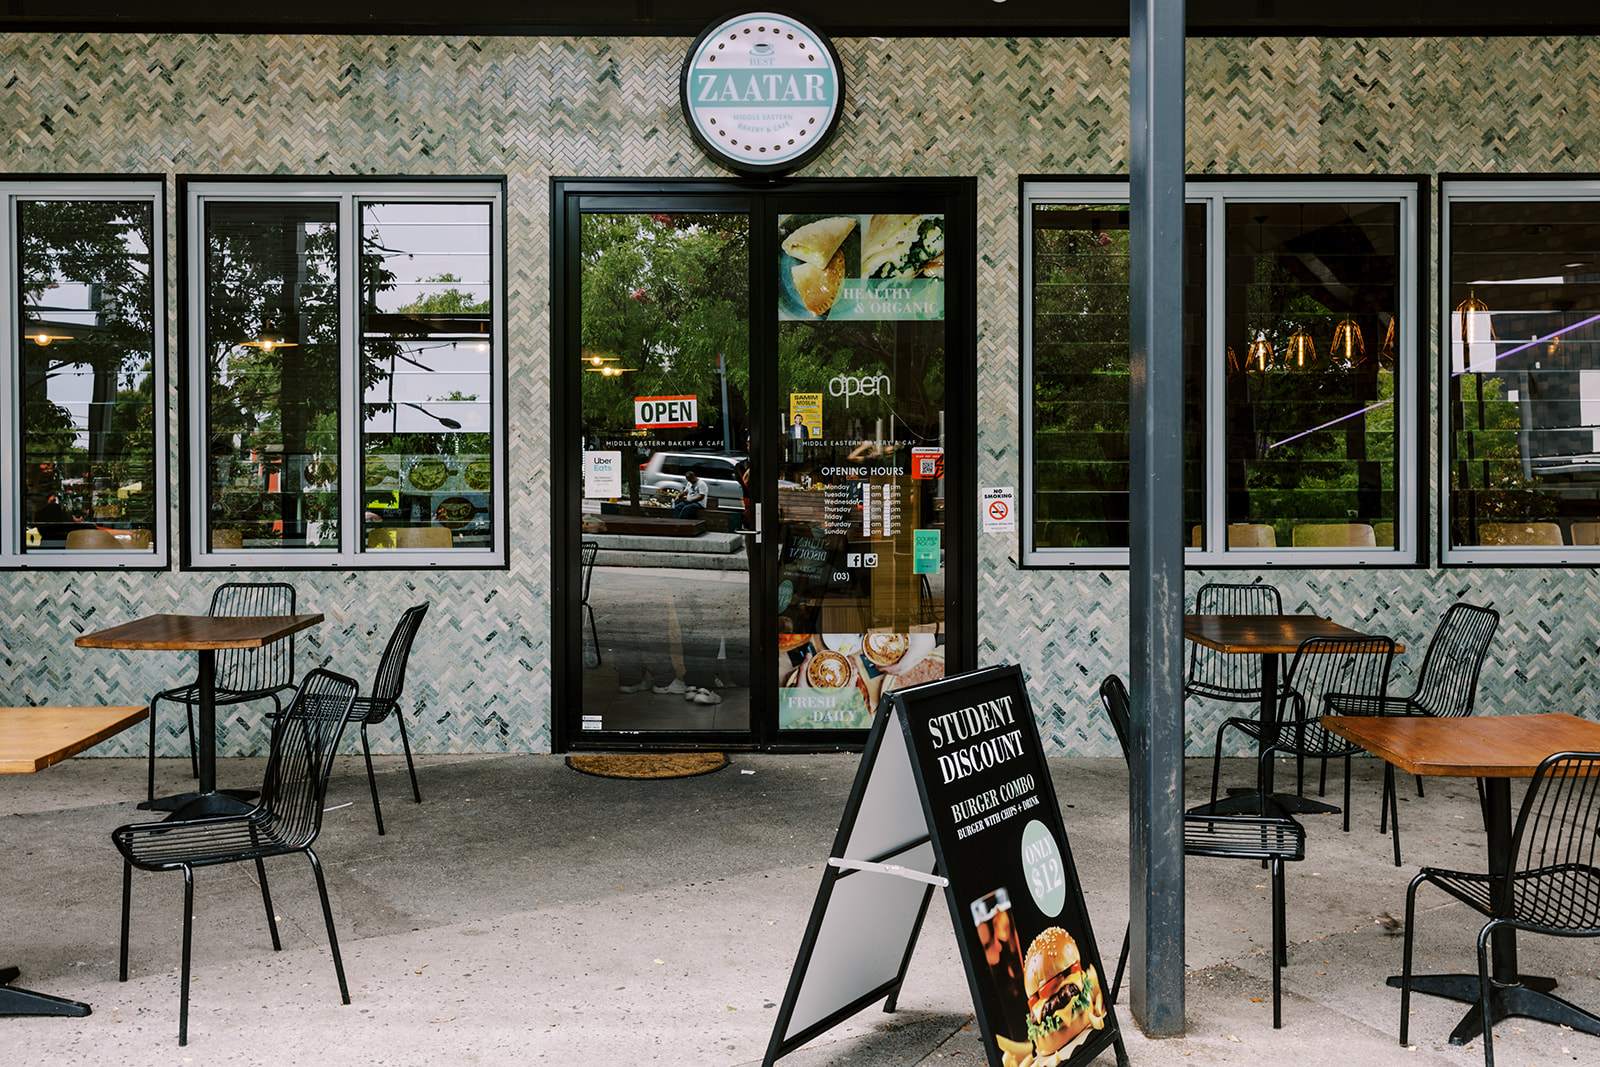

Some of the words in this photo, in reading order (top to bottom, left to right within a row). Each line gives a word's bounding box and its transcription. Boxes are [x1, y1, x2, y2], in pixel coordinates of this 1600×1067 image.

[749, 57, 776, 66] BEST
[697, 74, 827, 102] ZAATAR
[737, 122, 764, 133] BAKERY
[843, 288, 913, 300] HEALTHY
[854, 302, 865, 313] &
[870, 302, 938, 313] ORGANIC
[829, 375, 891, 409] open
[641, 401, 692, 423] OPEN
[593, 457, 612, 465] Uber
[593, 464, 612, 472] Eats
[821, 467, 868, 476] OPENING
[870, 467, 904, 476] HOURS
[833, 572, 850, 582] (03)
[788, 696, 836, 709] FRESH
[813, 710, 858, 722] DAILY
[928, 695, 1016, 749] STUDENT
[937, 730, 1025, 784] DISCOUNT
[950, 789, 1000, 823] BURGER
[999, 773, 1036, 804] COMBO
[957, 820, 985, 840] BURGER
[984, 812, 1001, 829] WITH
[1000, 804, 1018, 821] CHIPS
[1018, 804, 1023, 813] +
[1022, 794, 1040, 812] DRINK
[1024, 835, 1053, 866] ONLY
[1031, 858, 1063, 901] $12
